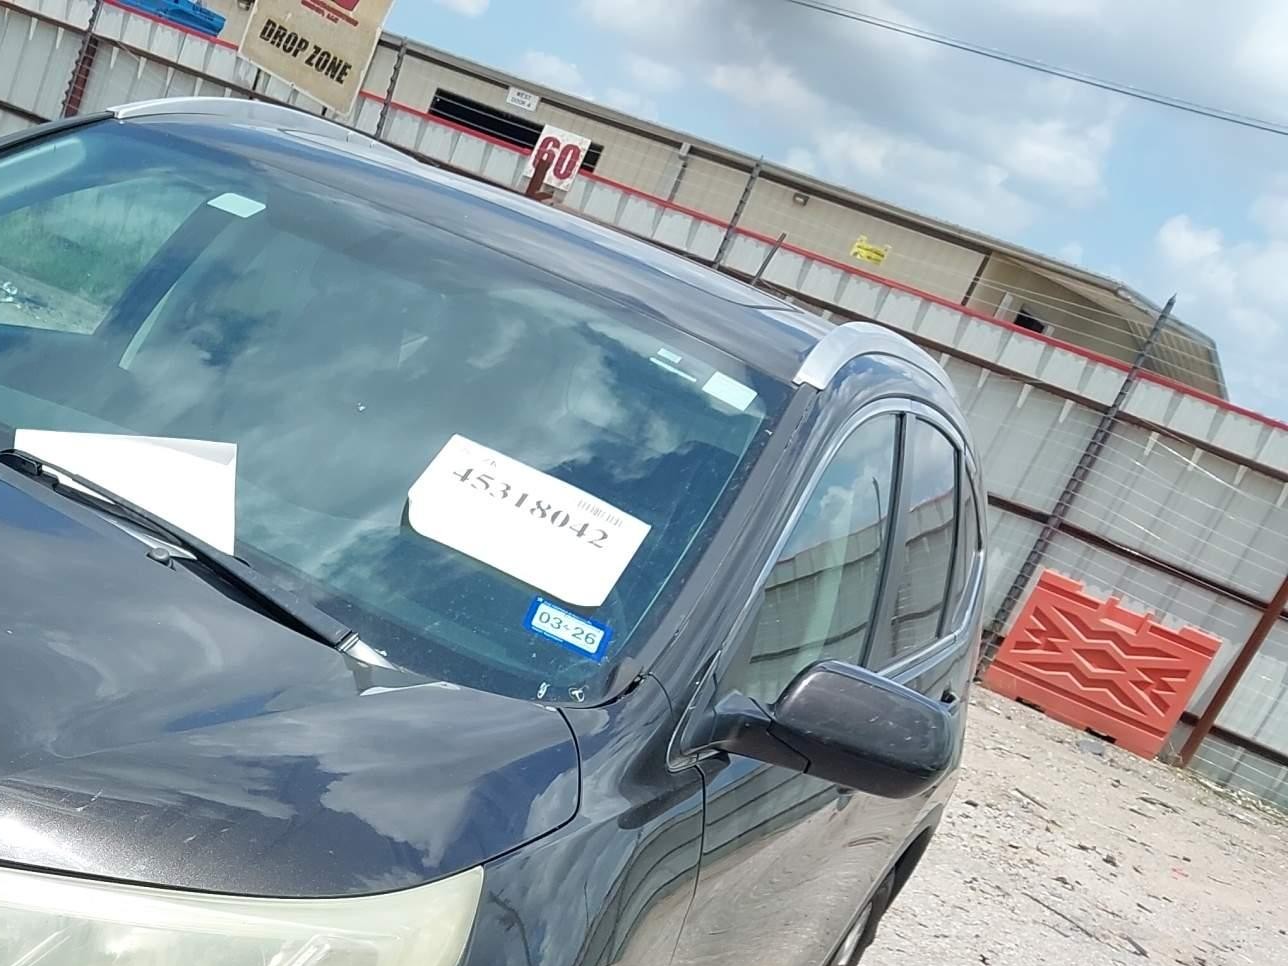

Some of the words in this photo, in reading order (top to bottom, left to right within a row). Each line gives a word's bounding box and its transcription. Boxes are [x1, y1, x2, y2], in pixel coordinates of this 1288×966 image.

[259, 18, 310, 58] DROP
[304, 44, 353, 85] ZONE
[532, 136, 582, 180] 60
[452, 467, 609, 549] 45318042
